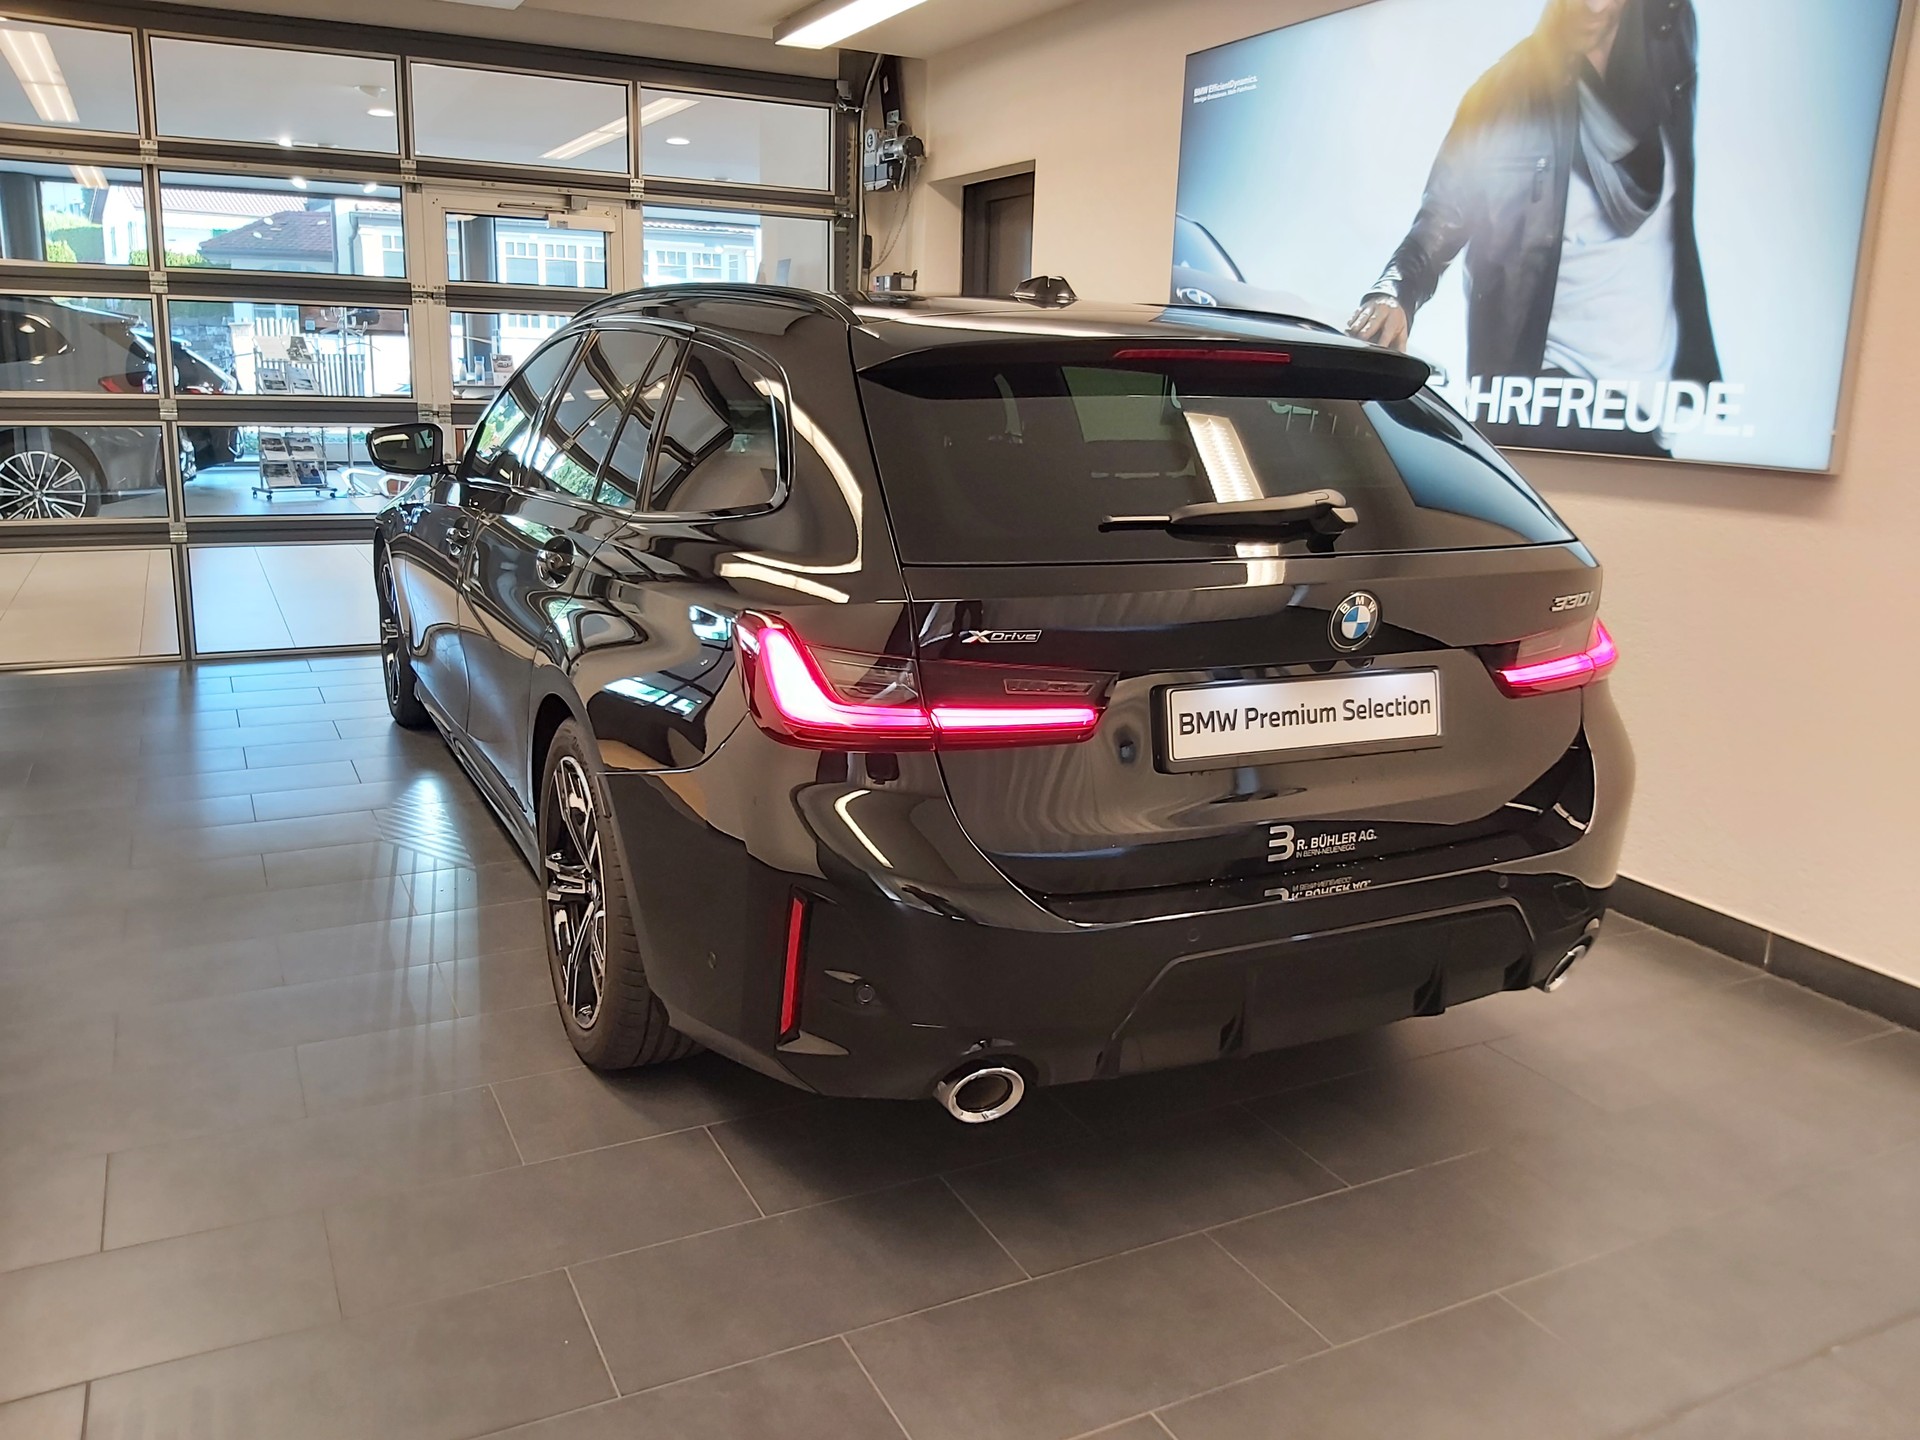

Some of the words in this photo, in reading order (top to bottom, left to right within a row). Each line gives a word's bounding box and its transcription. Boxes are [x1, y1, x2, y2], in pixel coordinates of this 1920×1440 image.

[1194, 86, 1208, 97] BMW
[1340, 596, 1376, 614] BMW
[1179, 708, 1238, 735] BMW
[1244, 703, 1337, 730] Premium
[1342, 695, 1431, 721] Selection
[1297, 839, 1309, 850] R.
[1311, 832, 1357, 848] BÜHLER
[1358, 829, 1378, 842] AG.
